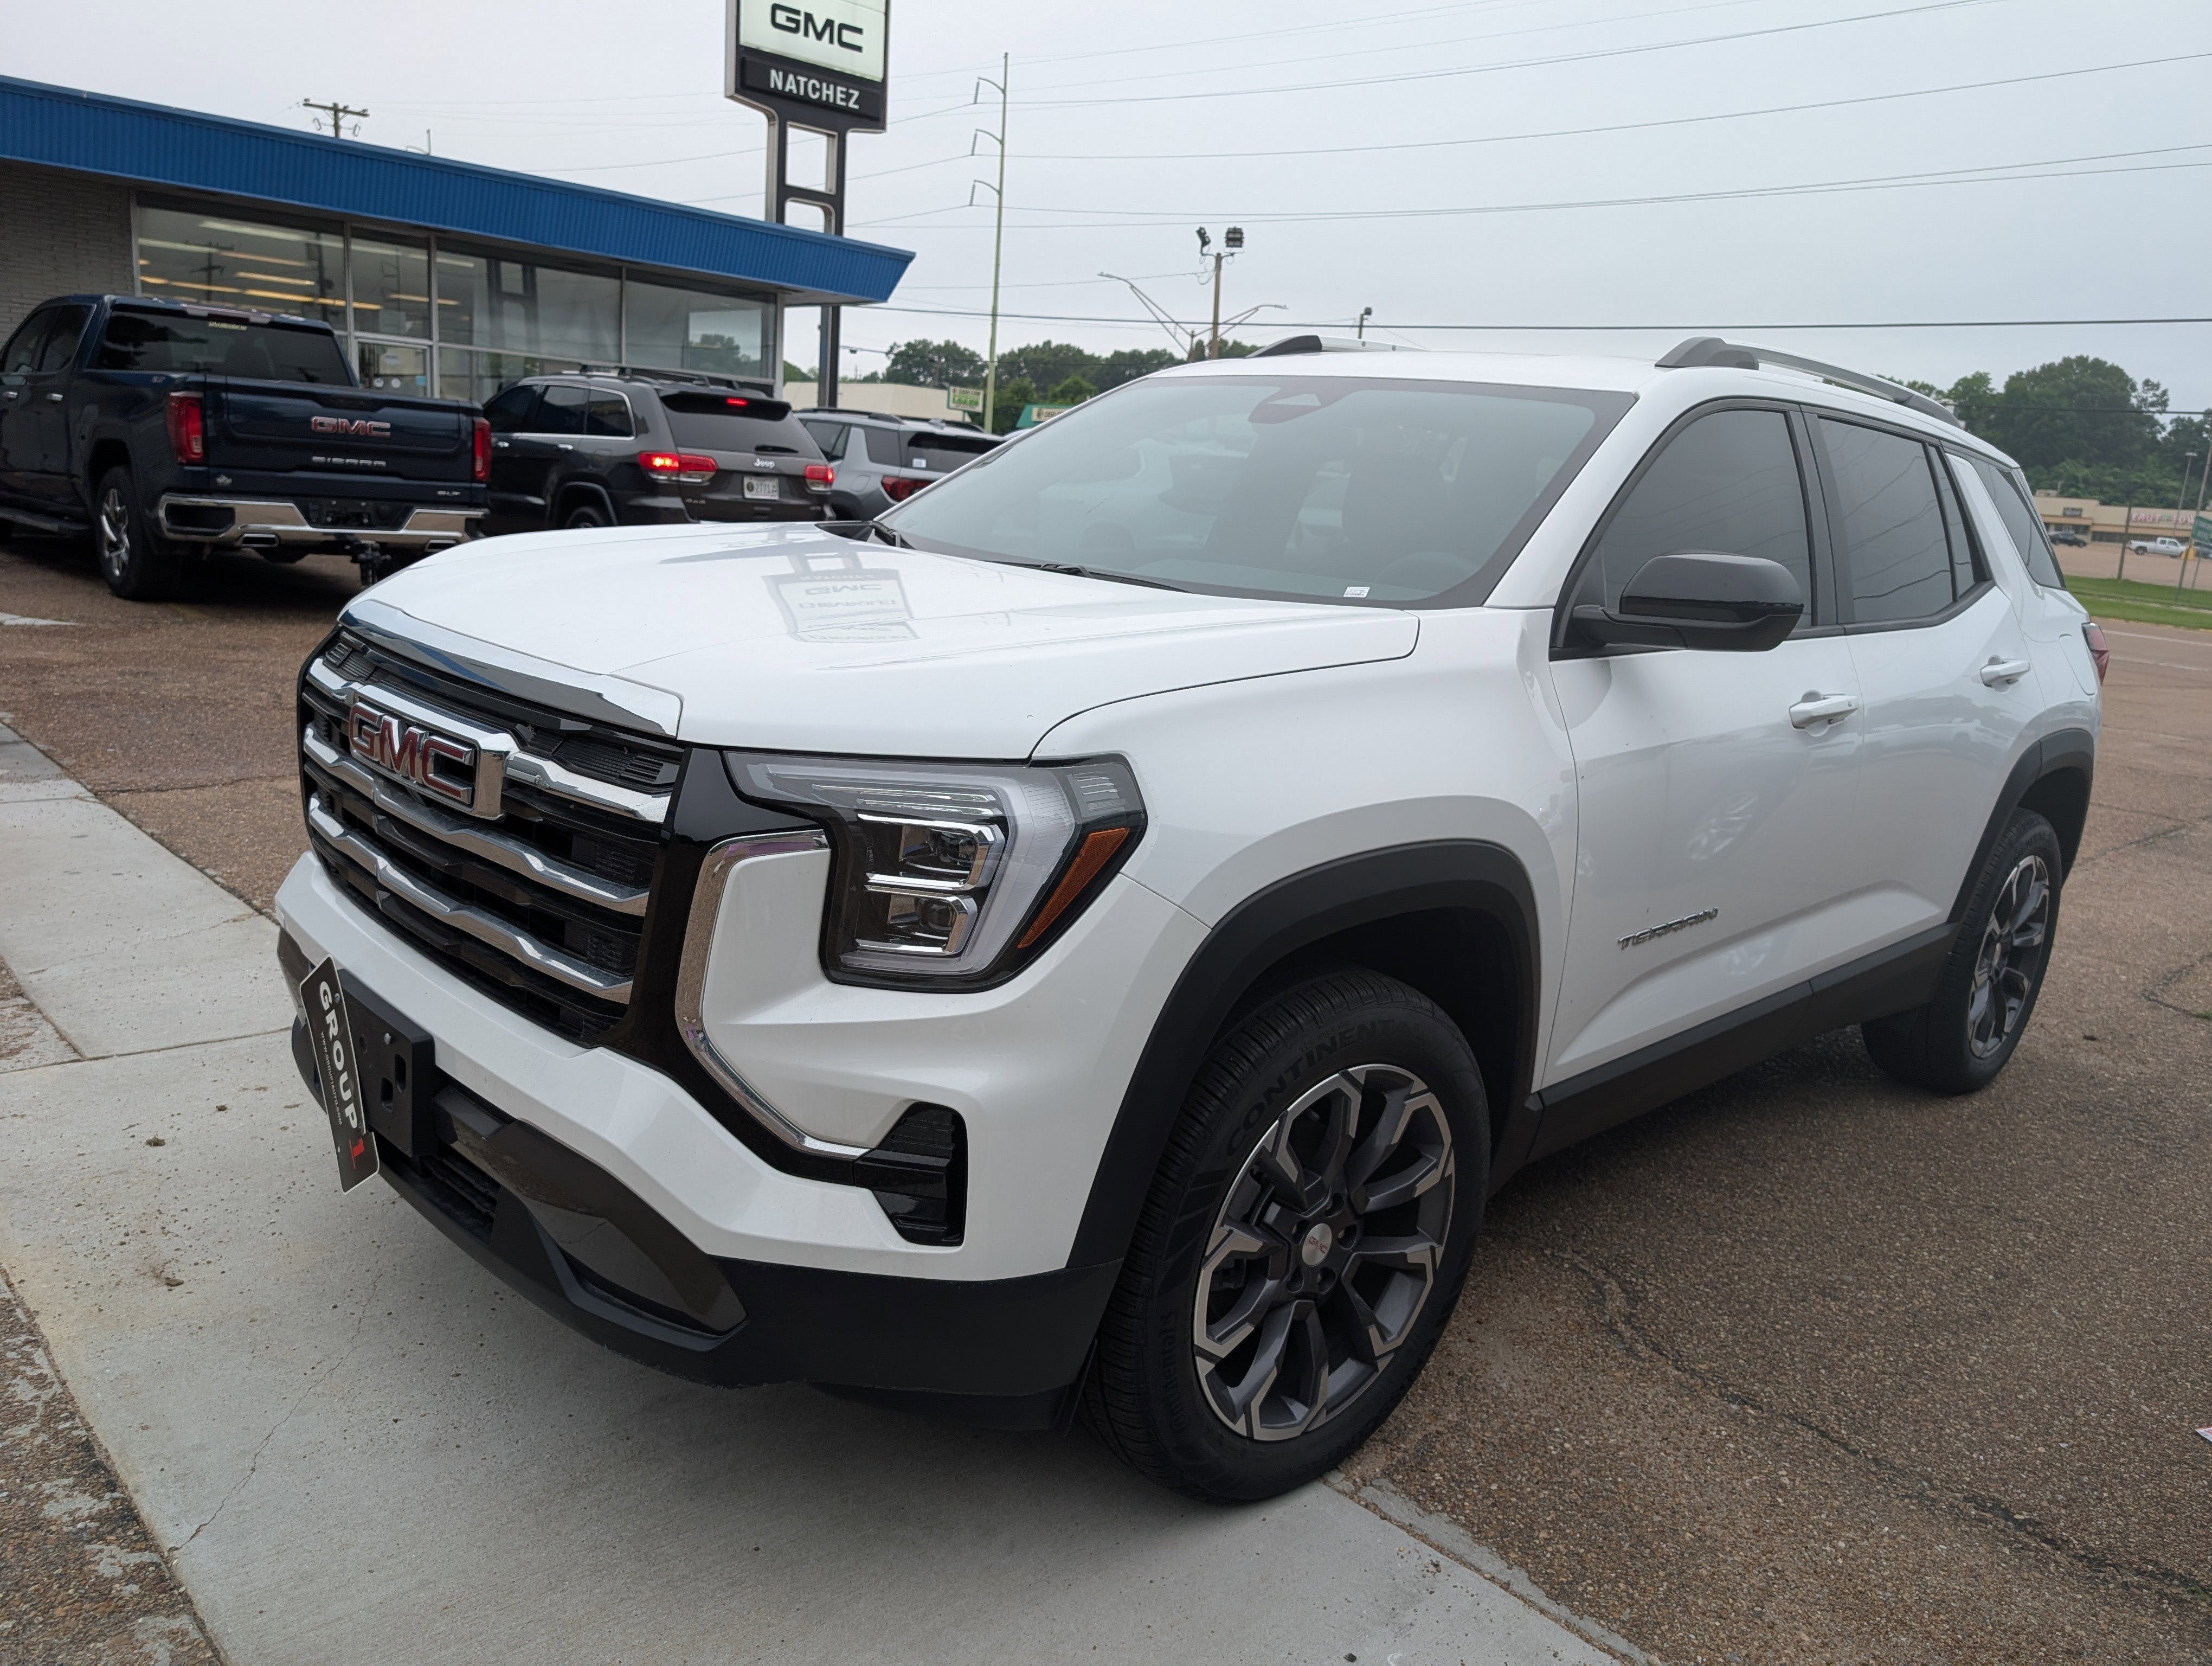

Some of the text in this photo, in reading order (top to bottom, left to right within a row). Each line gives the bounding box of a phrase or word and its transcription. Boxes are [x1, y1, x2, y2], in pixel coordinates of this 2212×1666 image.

[771, 3, 864, 53] GMC
[770, 68, 860, 110] NATCHEZ
[311, 416, 391, 438] GMC
[312, 456, 387, 467] SIERRA
[753, 457, 776, 470] Jeep
[349, 702, 474, 805] GMC
[319, 981, 364, 1170] GROUP 1
[1308, 1236, 1328, 1254] GMC
